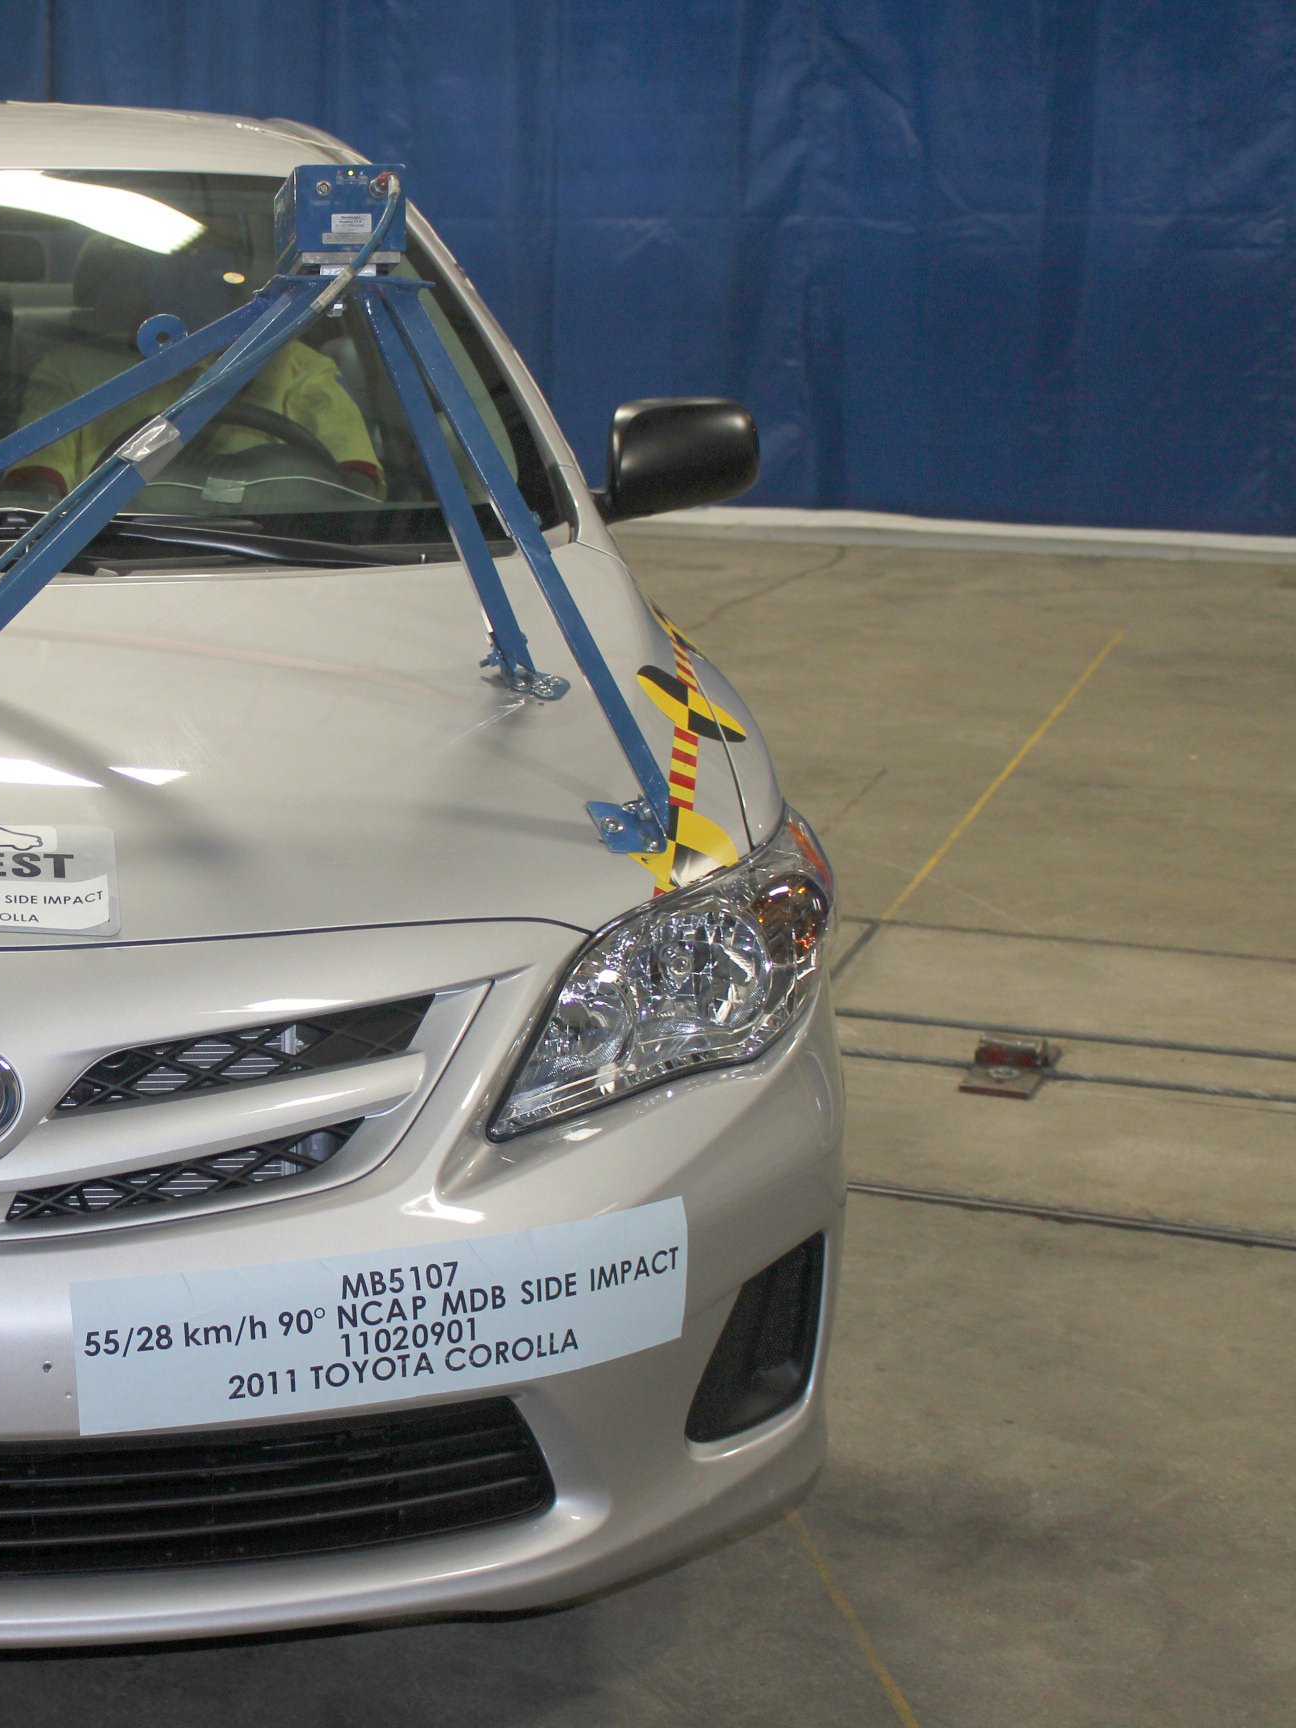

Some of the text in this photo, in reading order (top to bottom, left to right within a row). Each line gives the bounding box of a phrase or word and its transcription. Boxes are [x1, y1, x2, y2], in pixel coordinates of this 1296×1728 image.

[5, 895, 38, 904] SIDE
[44, 891, 103, 905] IMPACT
[341, 1261, 459, 1300] MB5107
[84, 1325, 173, 1358] 55/28
[184, 1315, 266, 1347] km/h
[337, 1296, 428, 1330] NCAP
[442, 1284, 507, 1316] MDB
[521, 1273, 577, 1304] SIDE
[590, 1246, 680, 1292] IMPACT
[341, 1317, 478, 1358] 11020901
[229, 1328, 579, 1400] 2011 TOYOTA COROLLA
